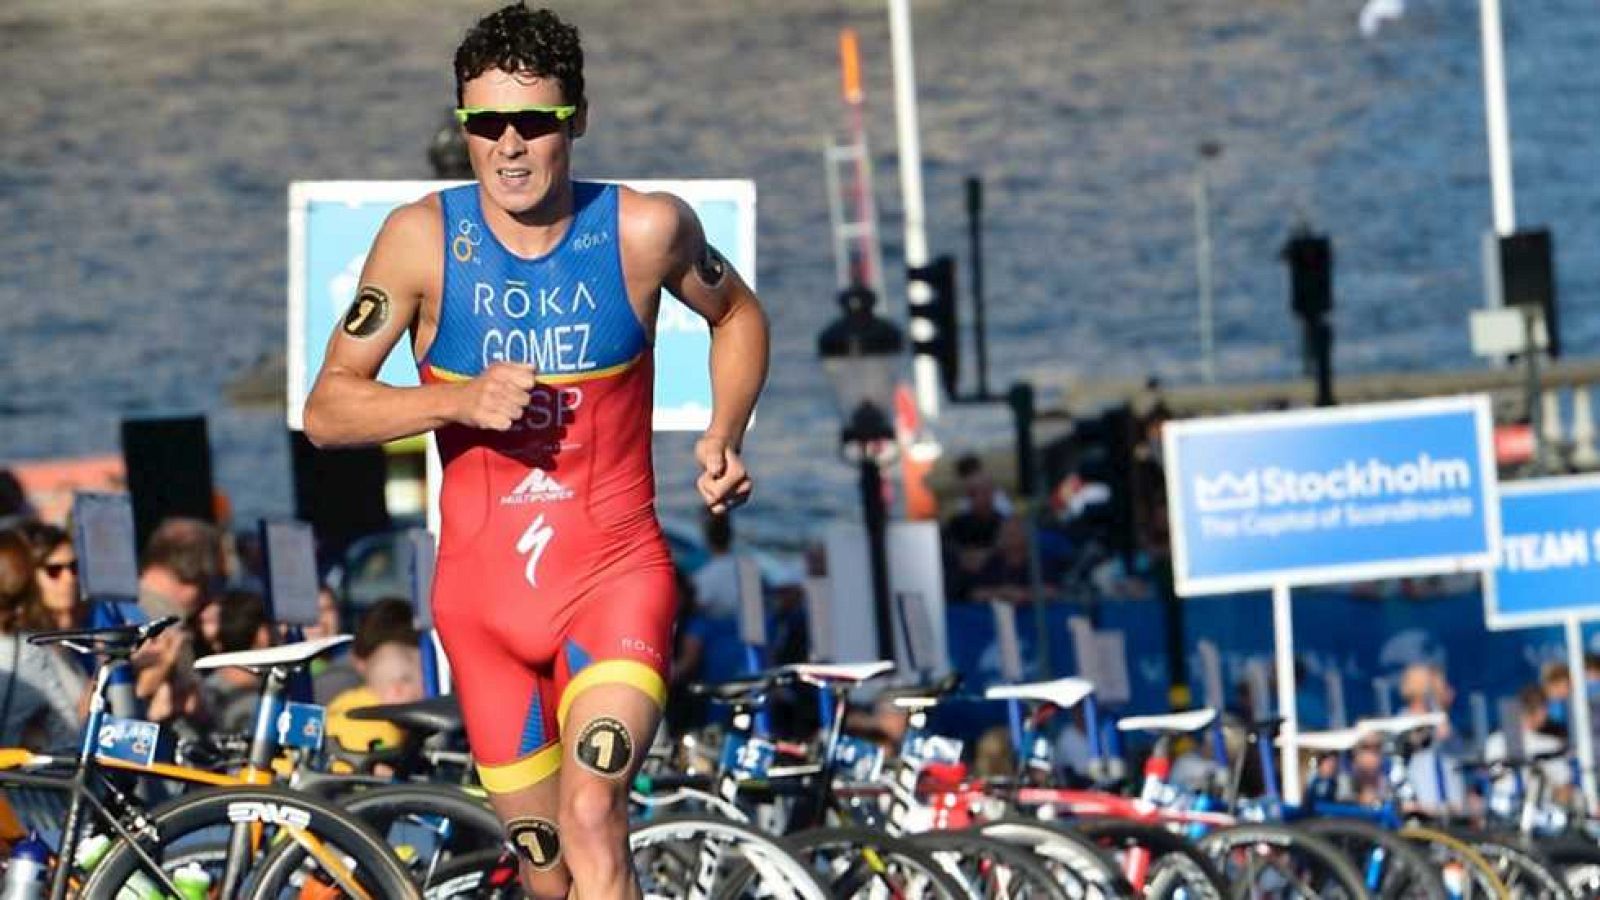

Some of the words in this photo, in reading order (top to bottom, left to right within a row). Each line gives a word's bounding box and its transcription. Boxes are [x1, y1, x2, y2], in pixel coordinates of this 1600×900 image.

[482, 323, 597, 372] GOMEZ
[511, 387, 583, 430] SP
[1261, 452, 1471, 505] Stockholm
[1503, 531, 1588, 573] TEAM
[591, 731, 614, 769] 1
[517, 832, 545, 863] 1
